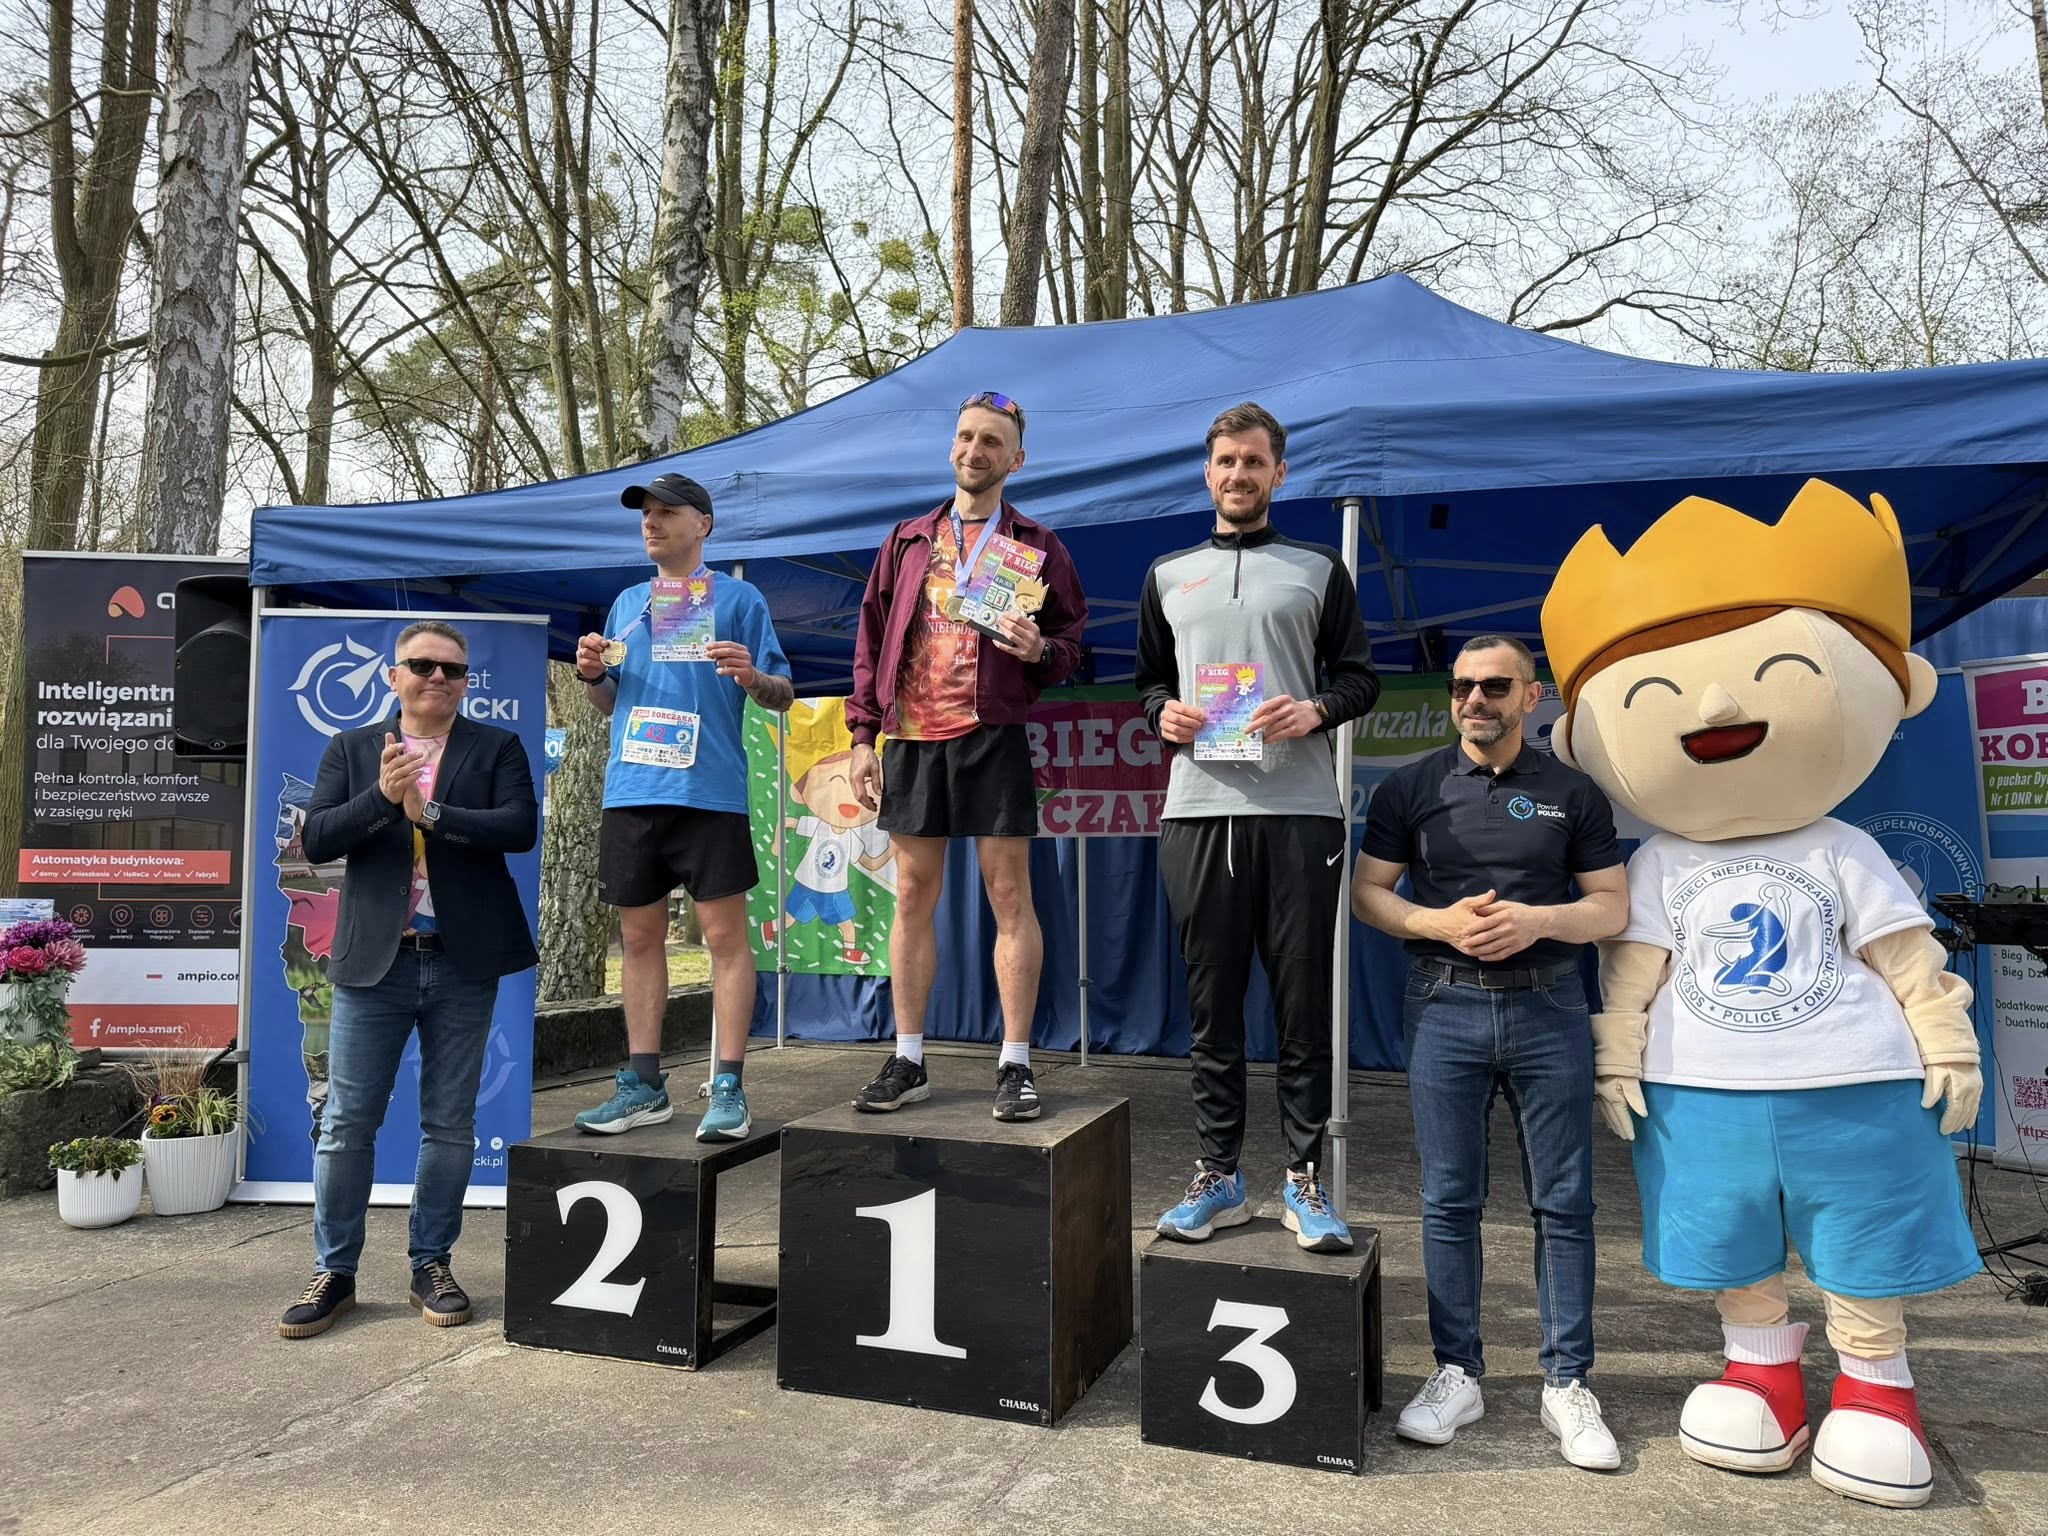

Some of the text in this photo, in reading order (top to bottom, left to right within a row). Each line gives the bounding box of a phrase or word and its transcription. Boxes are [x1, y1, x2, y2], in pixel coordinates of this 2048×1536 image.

[1014, 556, 1038, 572] BIEG
[38, 681, 175, 704] Inteligentn
[37, 707, 173, 731] rozwiązani
[652, 711, 693, 723] KORCZAKA
[645, 725, 666, 743] 42
[36, 734, 65, 750] dla
[70, 735, 148, 753] Twojego
[1025, 717, 1162, 769] BIEG
[34, 772, 199, 787] Pełna kontrola, komfort
[1989, 771, 2048, 789] o puchar Dy
[42, 790, 157, 804] bezpieczeństwo
[161, 793, 210, 802] zawsze
[1991, 793, 2003, 806] Nr
[2011, 791, 2033, 806] DNR
[2034, 794, 2043, 805] w
[34, 806, 133, 821] w zasięgu ręki
[1038, 793, 1168, 834] CZAK
[1537, 803, 1559, 811] Powiat
[1538, 810, 1566, 818] POLICKI
[32, 855, 184, 868] Automatyka budynkowa:
[72, 870, 110, 878] mieszkania
[1672, 877, 1708, 911] DZIECI
[1711, 861, 1835, 946] NIEPEŁNOSPRAWNYCH
[2001, 949, 2022, 963] Bieg
[2002, 966, 2023, 980] Bieg
[1722, 1009, 1783, 1024] POLICE
[474, 1156, 503, 1169] cki.pl
[551, 1180, 646, 1318] 2
[856, 1188, 967, 1359] 1
[656, 1345, 688, 1356] CHABAS
[1198, 1298, 1297, 1425] 3
[999, 1398, 1039, 1412] CHABAS
[1317, 1455, 1354, 1467] CHABAS
